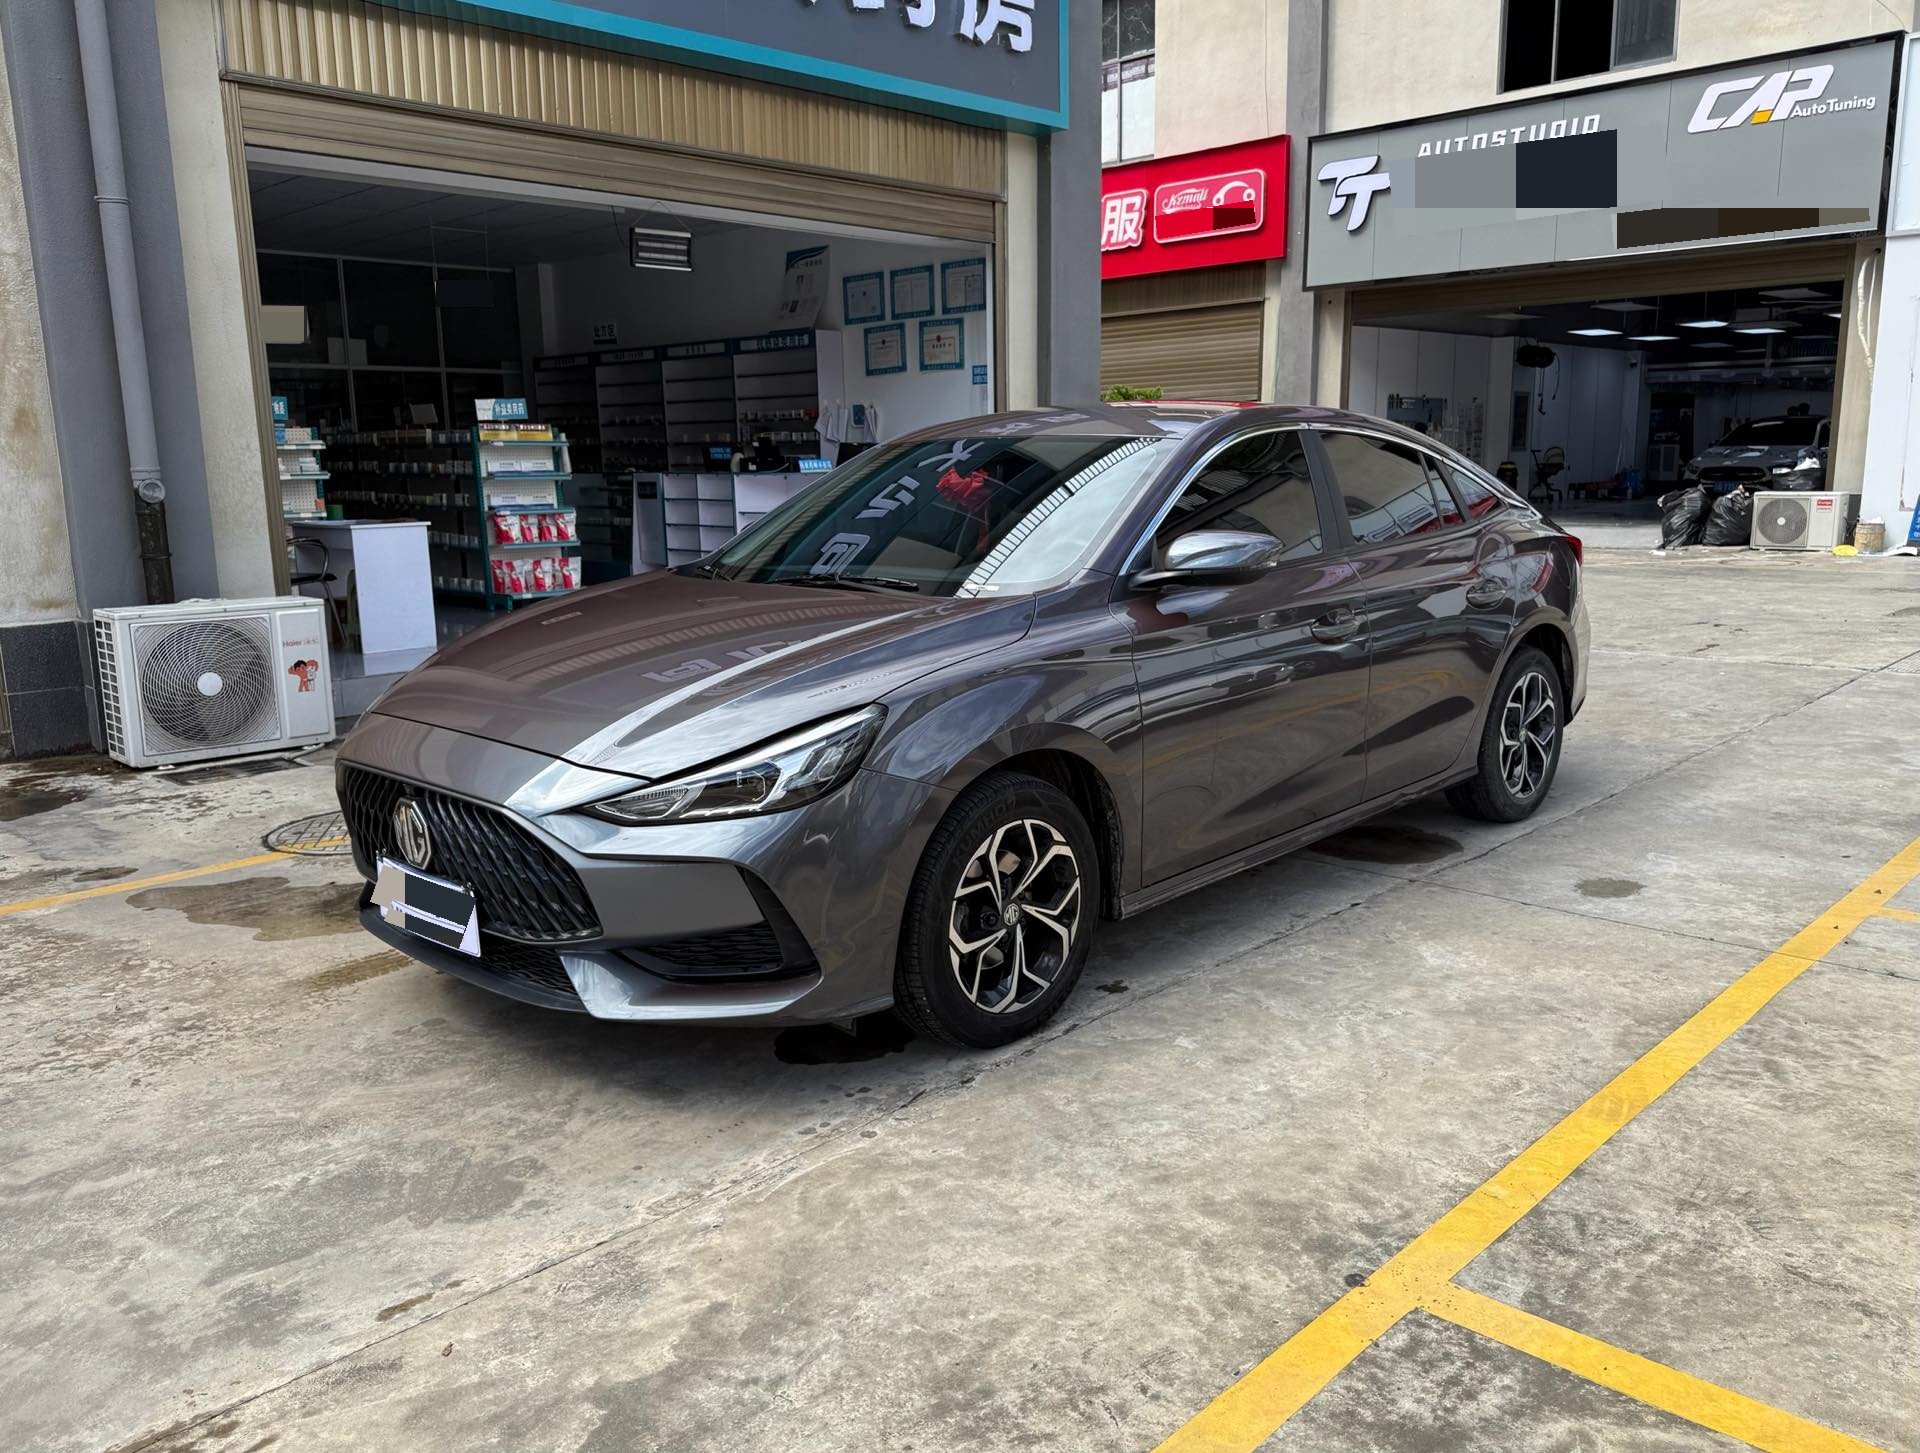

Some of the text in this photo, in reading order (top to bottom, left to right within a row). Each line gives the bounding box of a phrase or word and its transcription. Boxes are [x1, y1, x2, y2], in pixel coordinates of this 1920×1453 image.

[1101, 195, 1142, 246] 服
[282, 640, 302, 648] Haier
[394, 802, 428, 867] MG
[1004, 904, 1019, 925] MG
